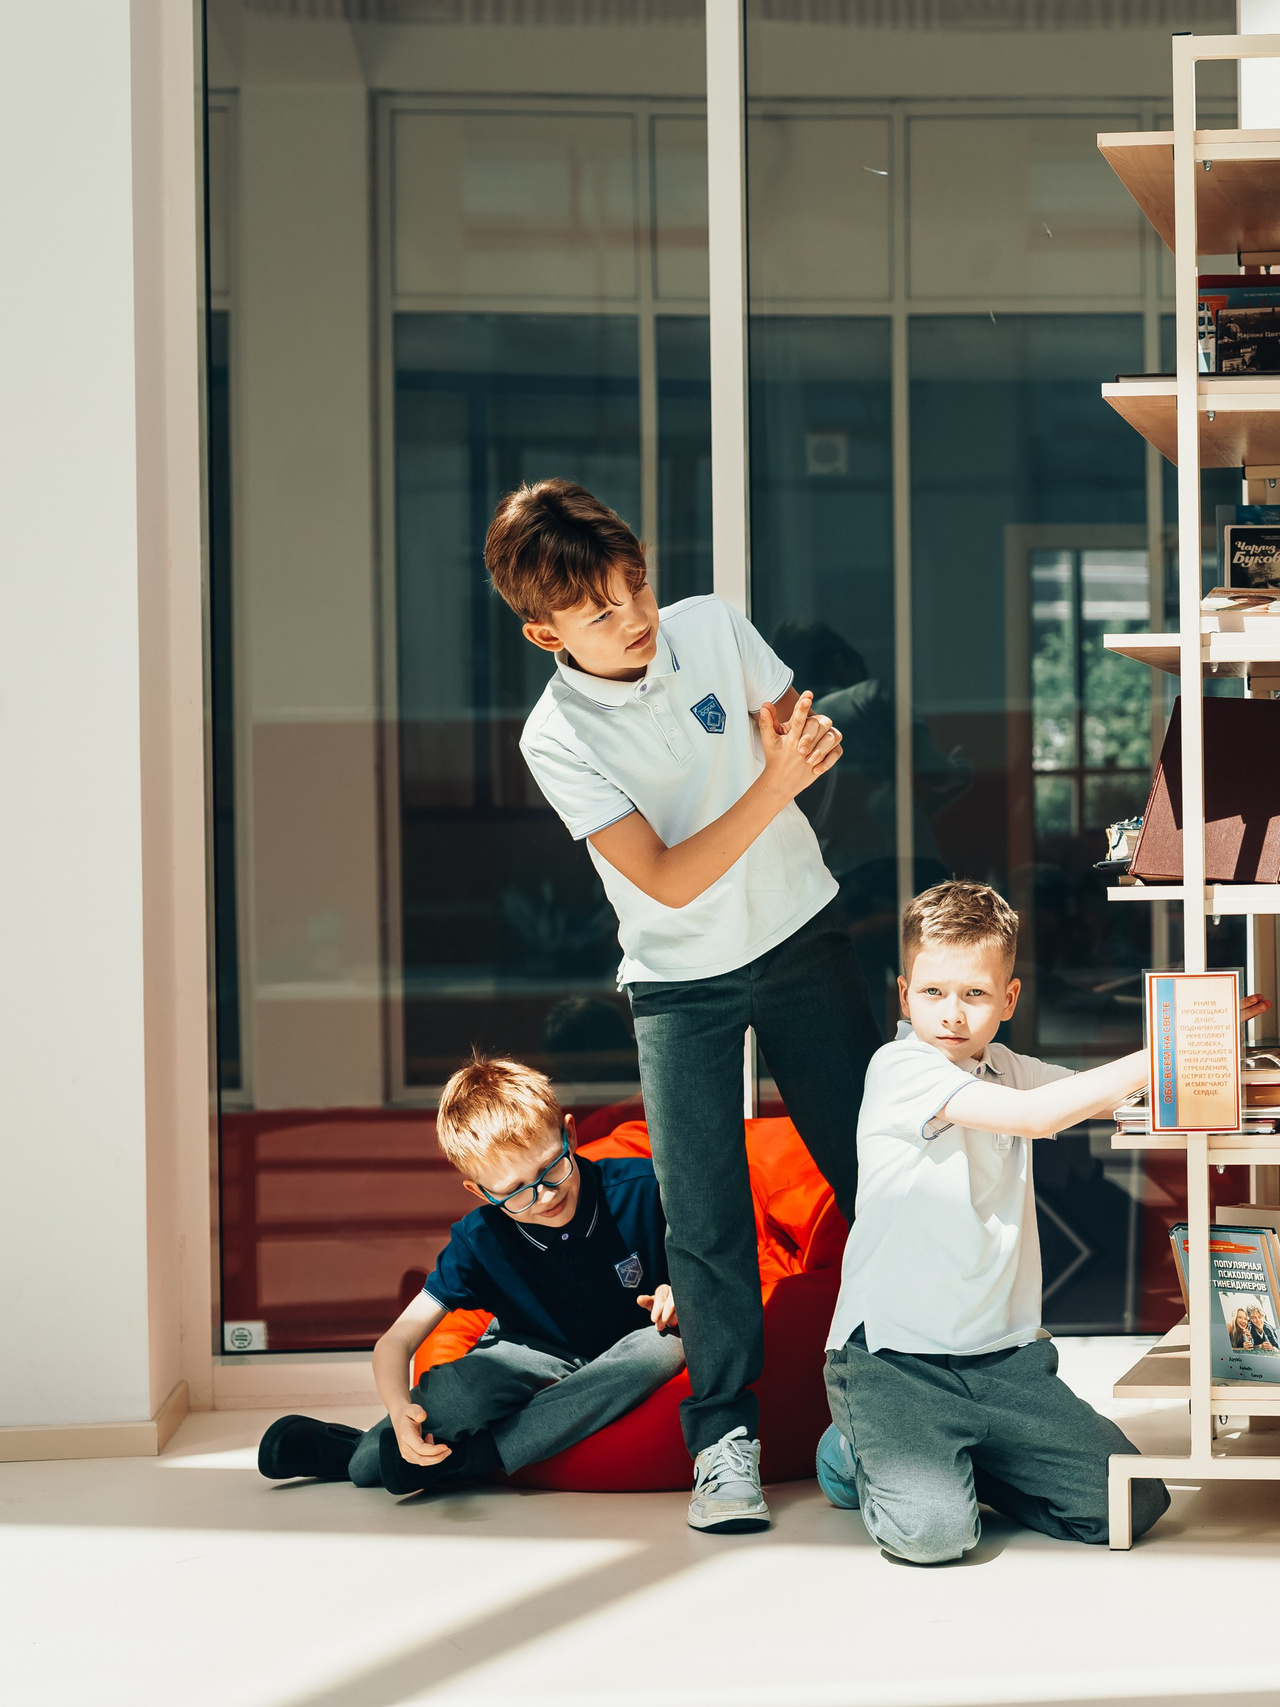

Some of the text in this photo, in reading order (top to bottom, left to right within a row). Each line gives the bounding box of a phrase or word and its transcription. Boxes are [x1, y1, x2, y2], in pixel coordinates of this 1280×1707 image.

[1162, 1001, 1173, 1103] ОБО ВСЕМ НА СВЕТЕ
[1213, 1259, 1263, 1272] ПОПУЛЯРНАЯ
[1218, 1270, 1265, 1282] ПСИХОЛОГИЯ
[1212, 1279, 1268, 1292] ТИНЕЙДЖЕРОВ
